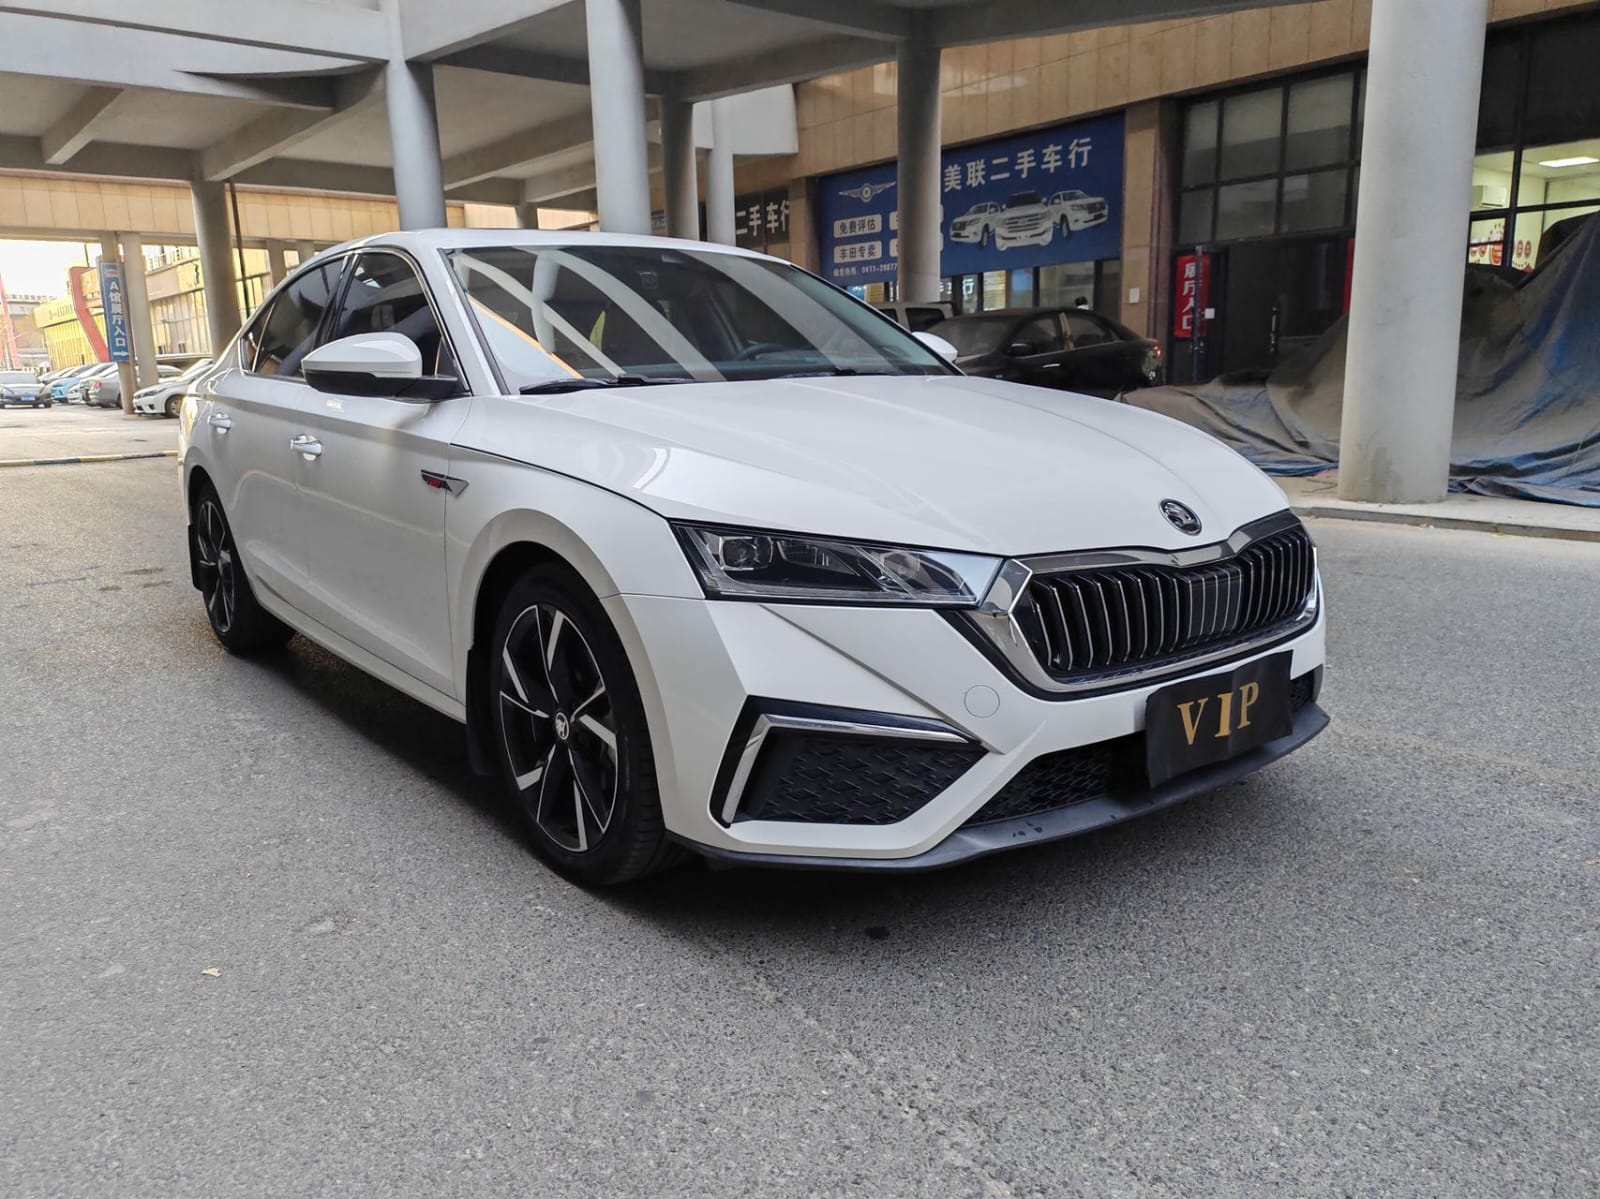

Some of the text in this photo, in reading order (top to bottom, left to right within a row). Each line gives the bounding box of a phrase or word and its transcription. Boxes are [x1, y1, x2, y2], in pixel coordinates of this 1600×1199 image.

[944, 137, 1092, 192] 美联二手车行
[839, 219, 876, 234] 免费评估
[839, 244, 876, 260] 丰田专卖
[109, 281, 126, 347] A馆展厅入口
[1177, 681, 1259, 745] VIP
